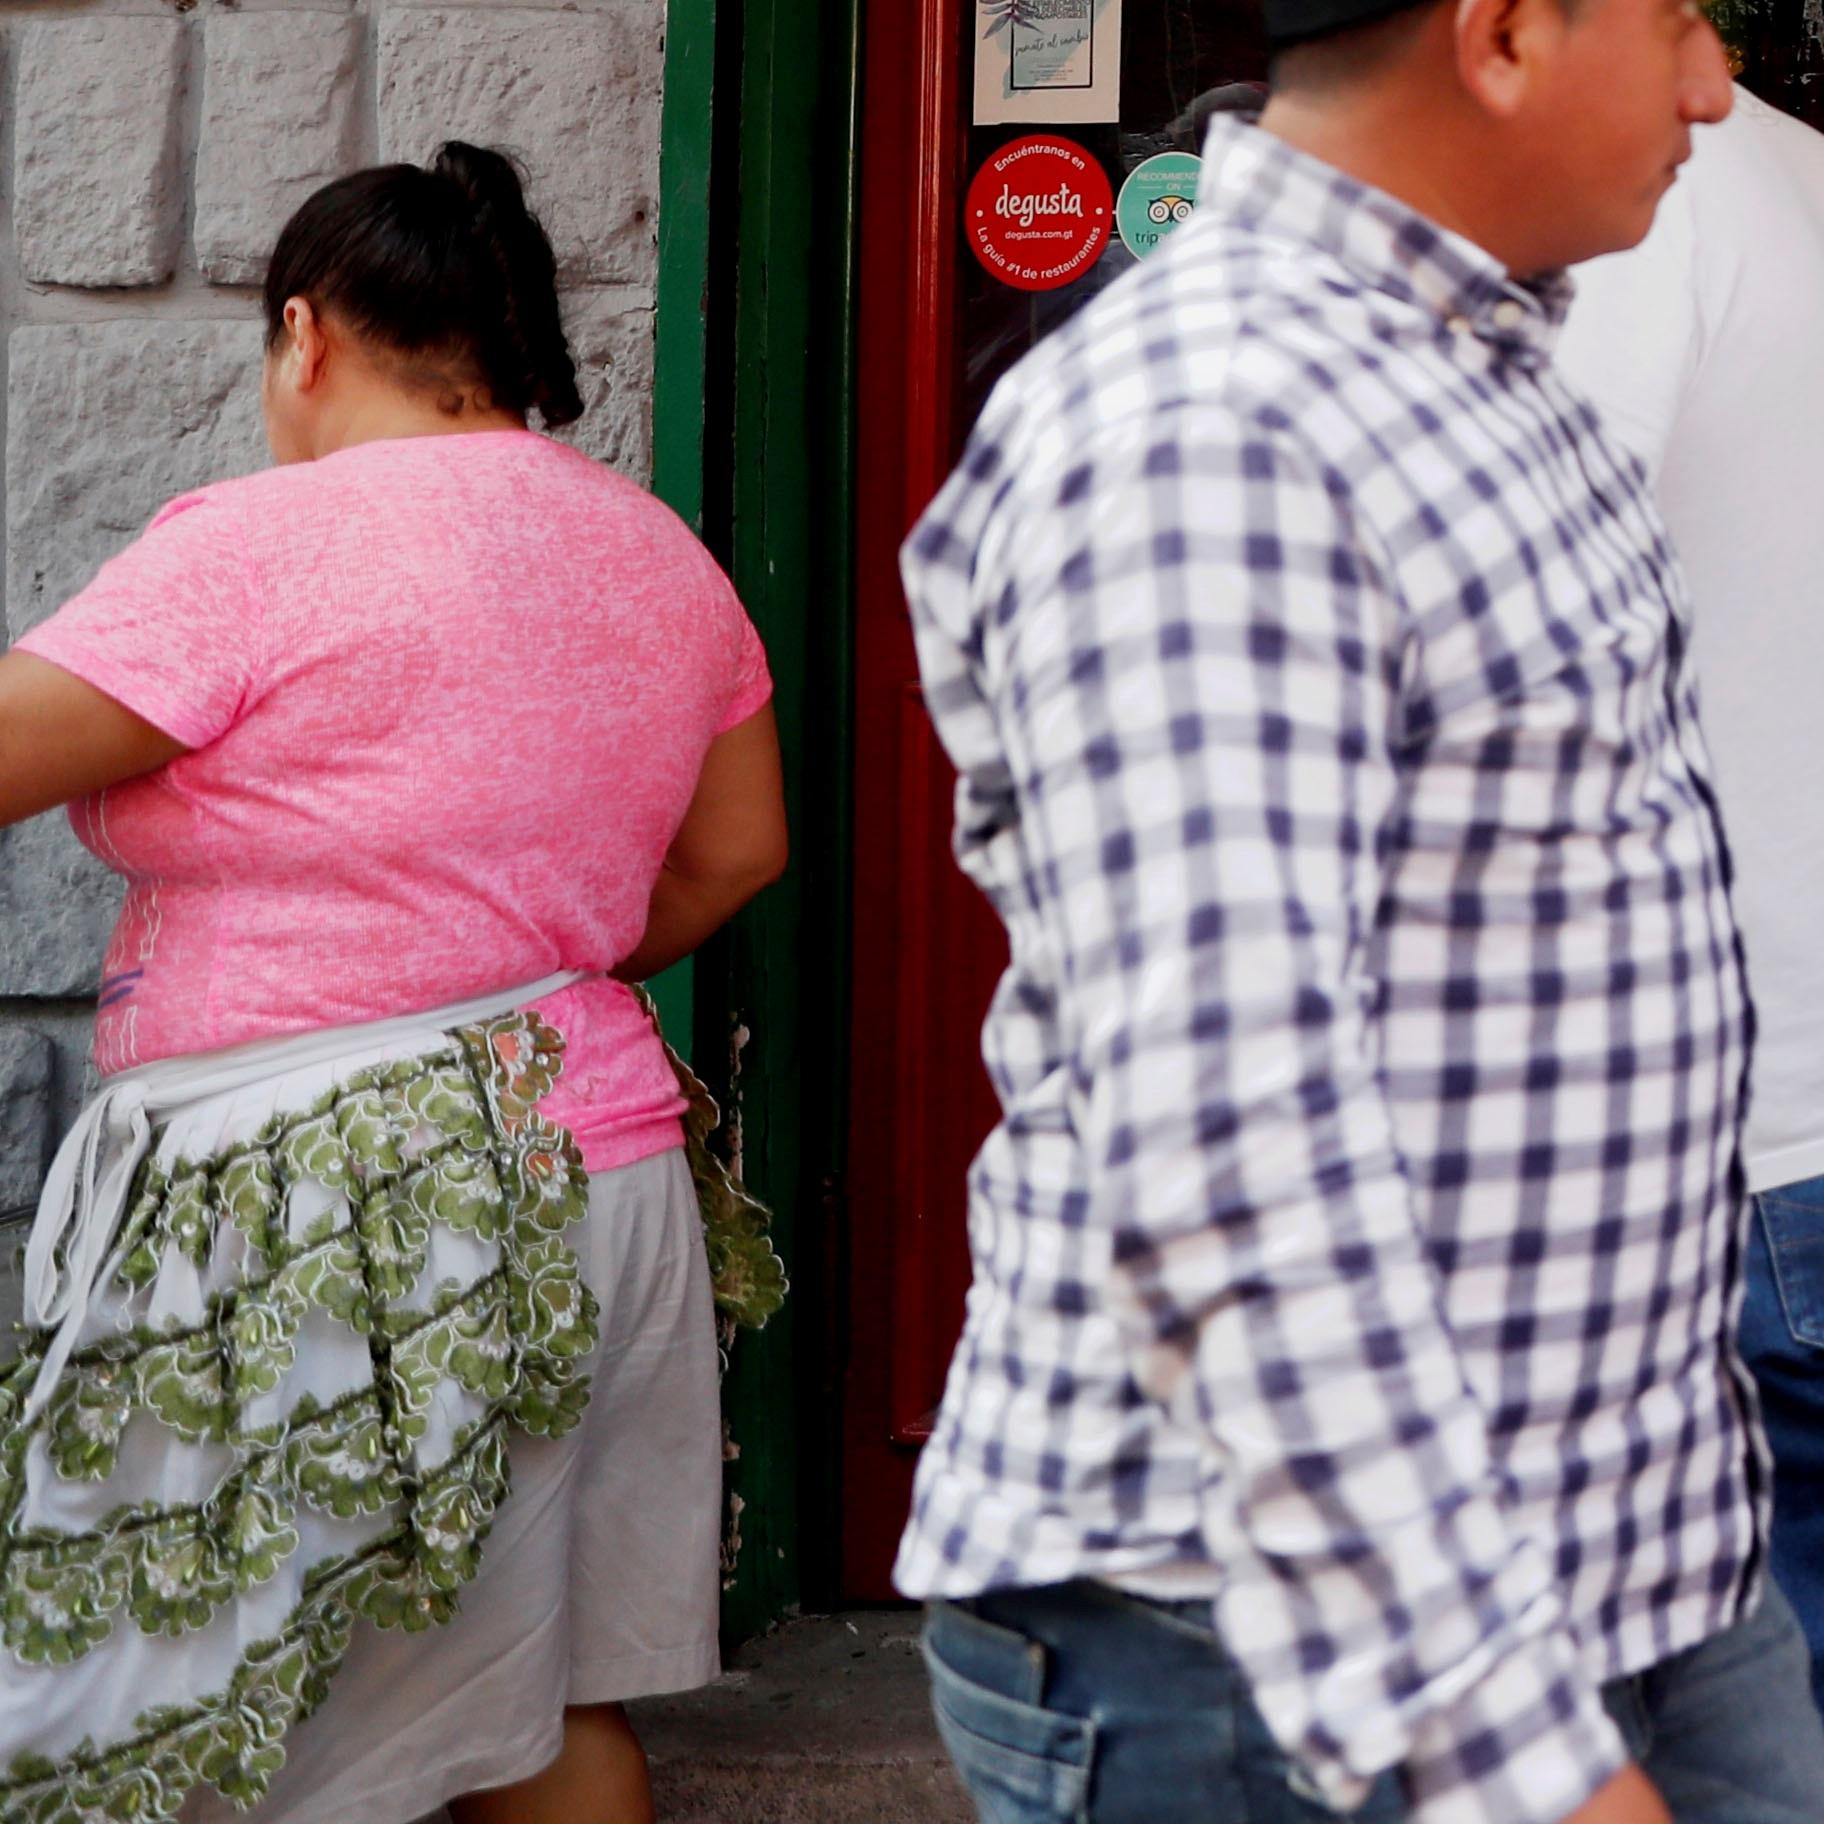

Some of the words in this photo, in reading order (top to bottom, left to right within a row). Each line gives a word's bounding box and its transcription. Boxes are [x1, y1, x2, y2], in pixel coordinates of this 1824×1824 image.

[994, 144, 1071, 172] Encuéntranos
[1071, 155, 1086, 170] en
[995, 182, 1084, 227] degusta
[977, 227, 988, 242] La
[1004, 230, 1073, 241] degusta.com.gt
[982, 243, 1006, 267] guía
[1040, 227, 1101, 279] restaurantes
[1006, 263, 1020, 275] #1
[1022, 267, 1037, 279] de
